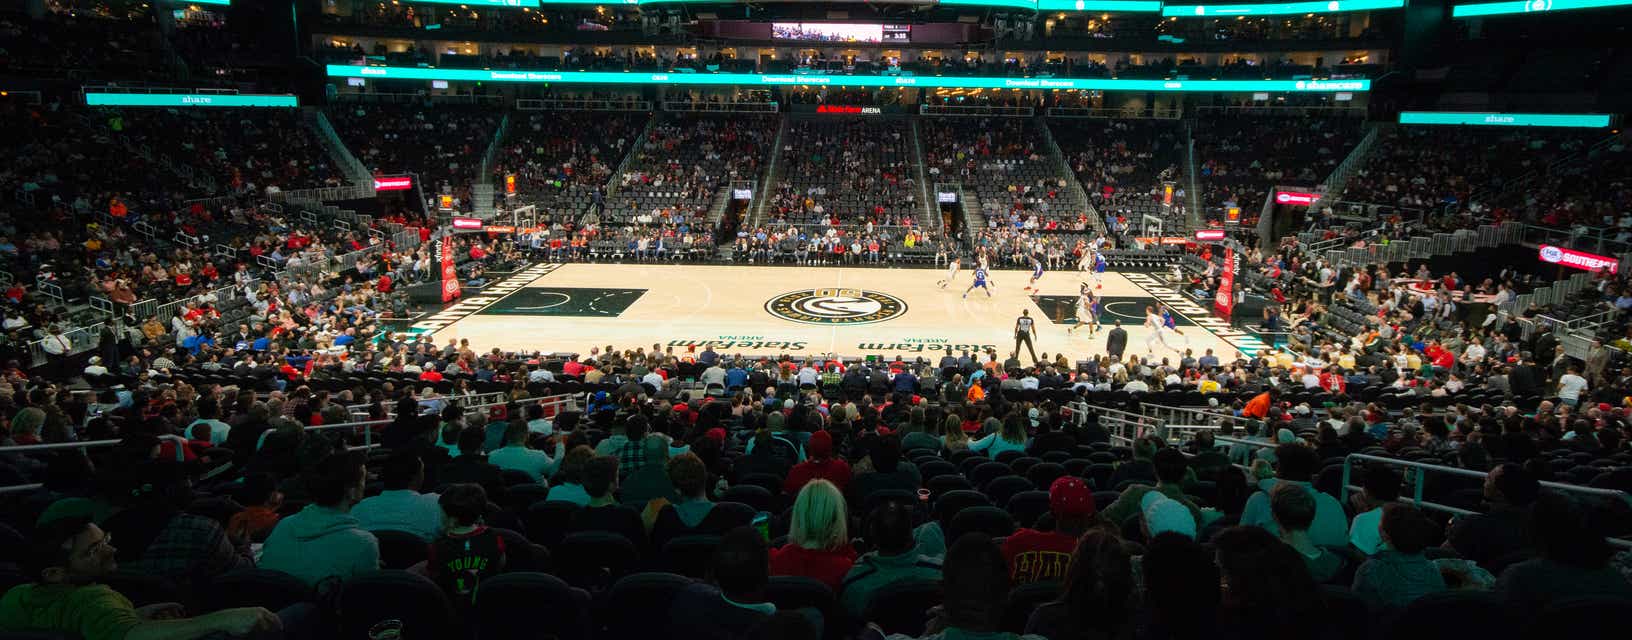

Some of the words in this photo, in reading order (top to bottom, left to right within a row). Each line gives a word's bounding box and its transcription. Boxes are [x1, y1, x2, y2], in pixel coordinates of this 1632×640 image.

[182, 96, 212, 104] share
[1485, 114, 1515, 123] share
[391, 296, 500, 345] LANTA
[480, 262, 563, 294] HAWKS
[1120, 272, 1210, 315] ATLANTA
[1190, 317, 1276, 359] HAW
[447, 555, 488, 573] YOUNG
